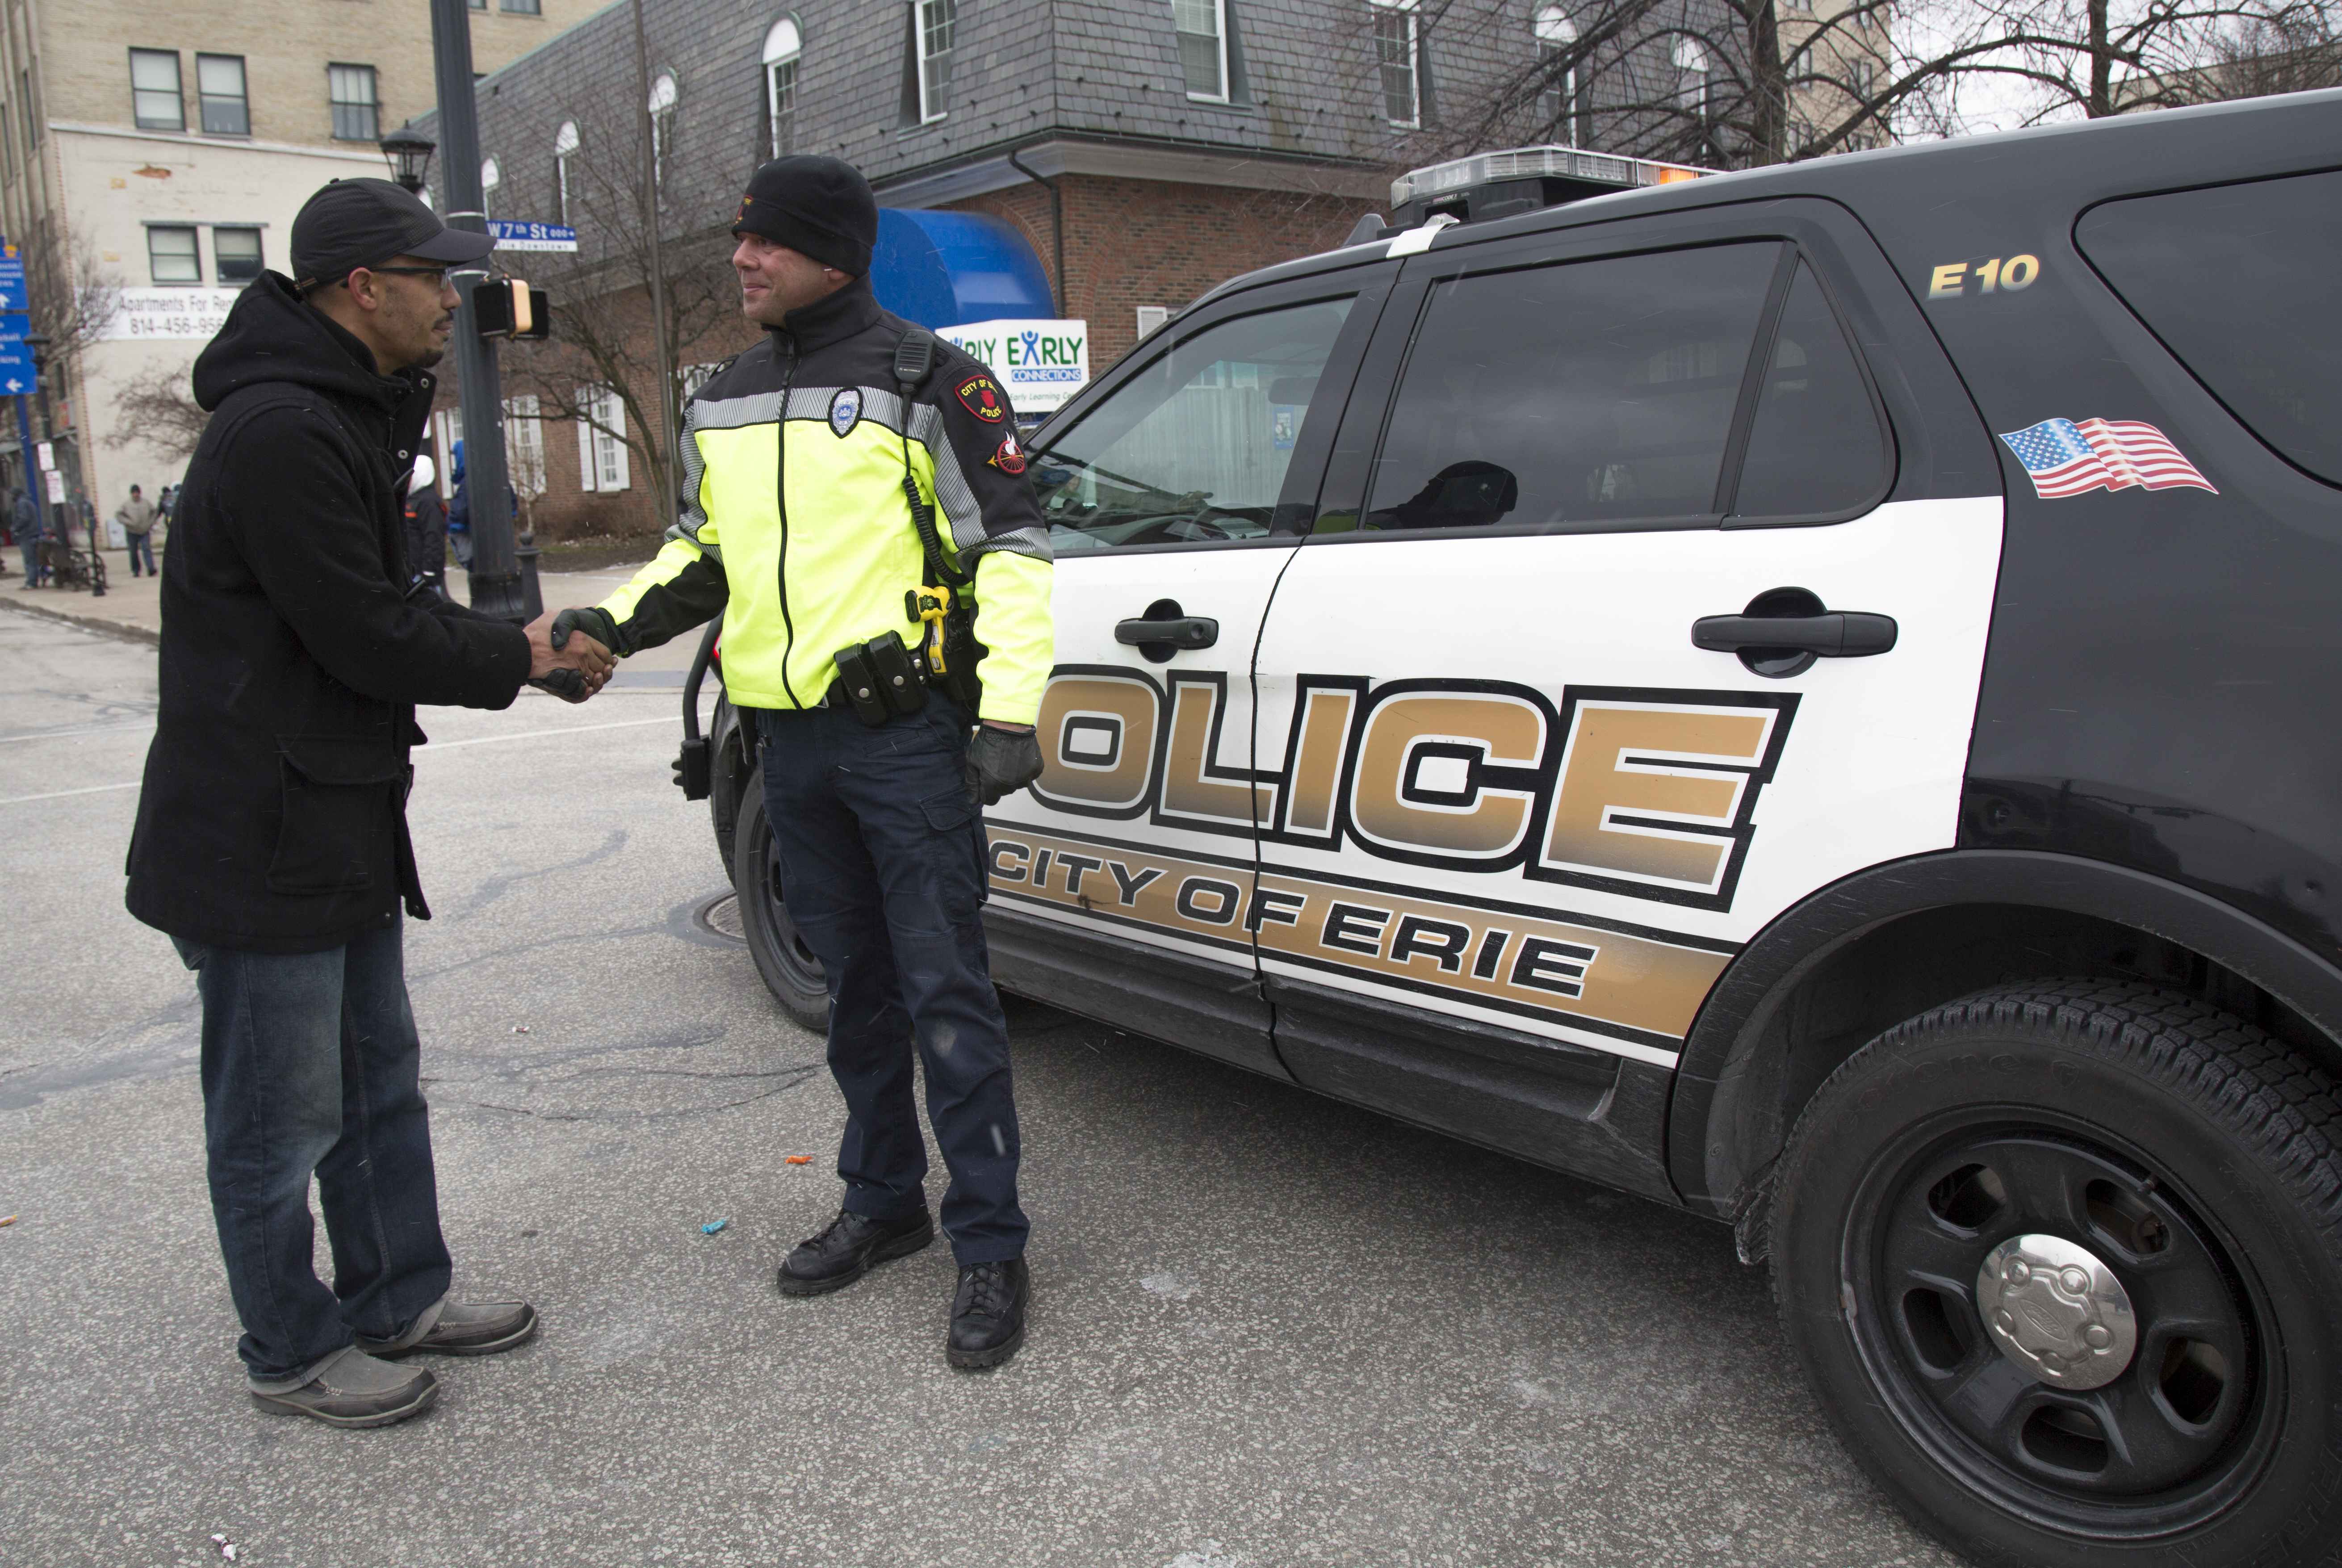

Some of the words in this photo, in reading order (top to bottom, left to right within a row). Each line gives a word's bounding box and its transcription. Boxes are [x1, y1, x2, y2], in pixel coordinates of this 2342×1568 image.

[486, 222, 501, 238] W
[530, 223, 548, 239] St
[119, 295, 184, 316] Apartments
[189, 295, 207, 311] For
[213, 295, 237, 311] Ren
[1012, 370, 1081, 382] CONNECTIONS
[961, 381, 977, 396] CITY
[979, 379, 986, 387] OF
[1029, 392, 1060, 401] Learning
[980, 406, 1002, 417] POLICE
[1027, 663, 1802, 913] OLICE
[988, 839, 1169, 907] CITY
[1174, 875, 1309, 934] OF
[1319, 899, 1600, 1001] ERIE
